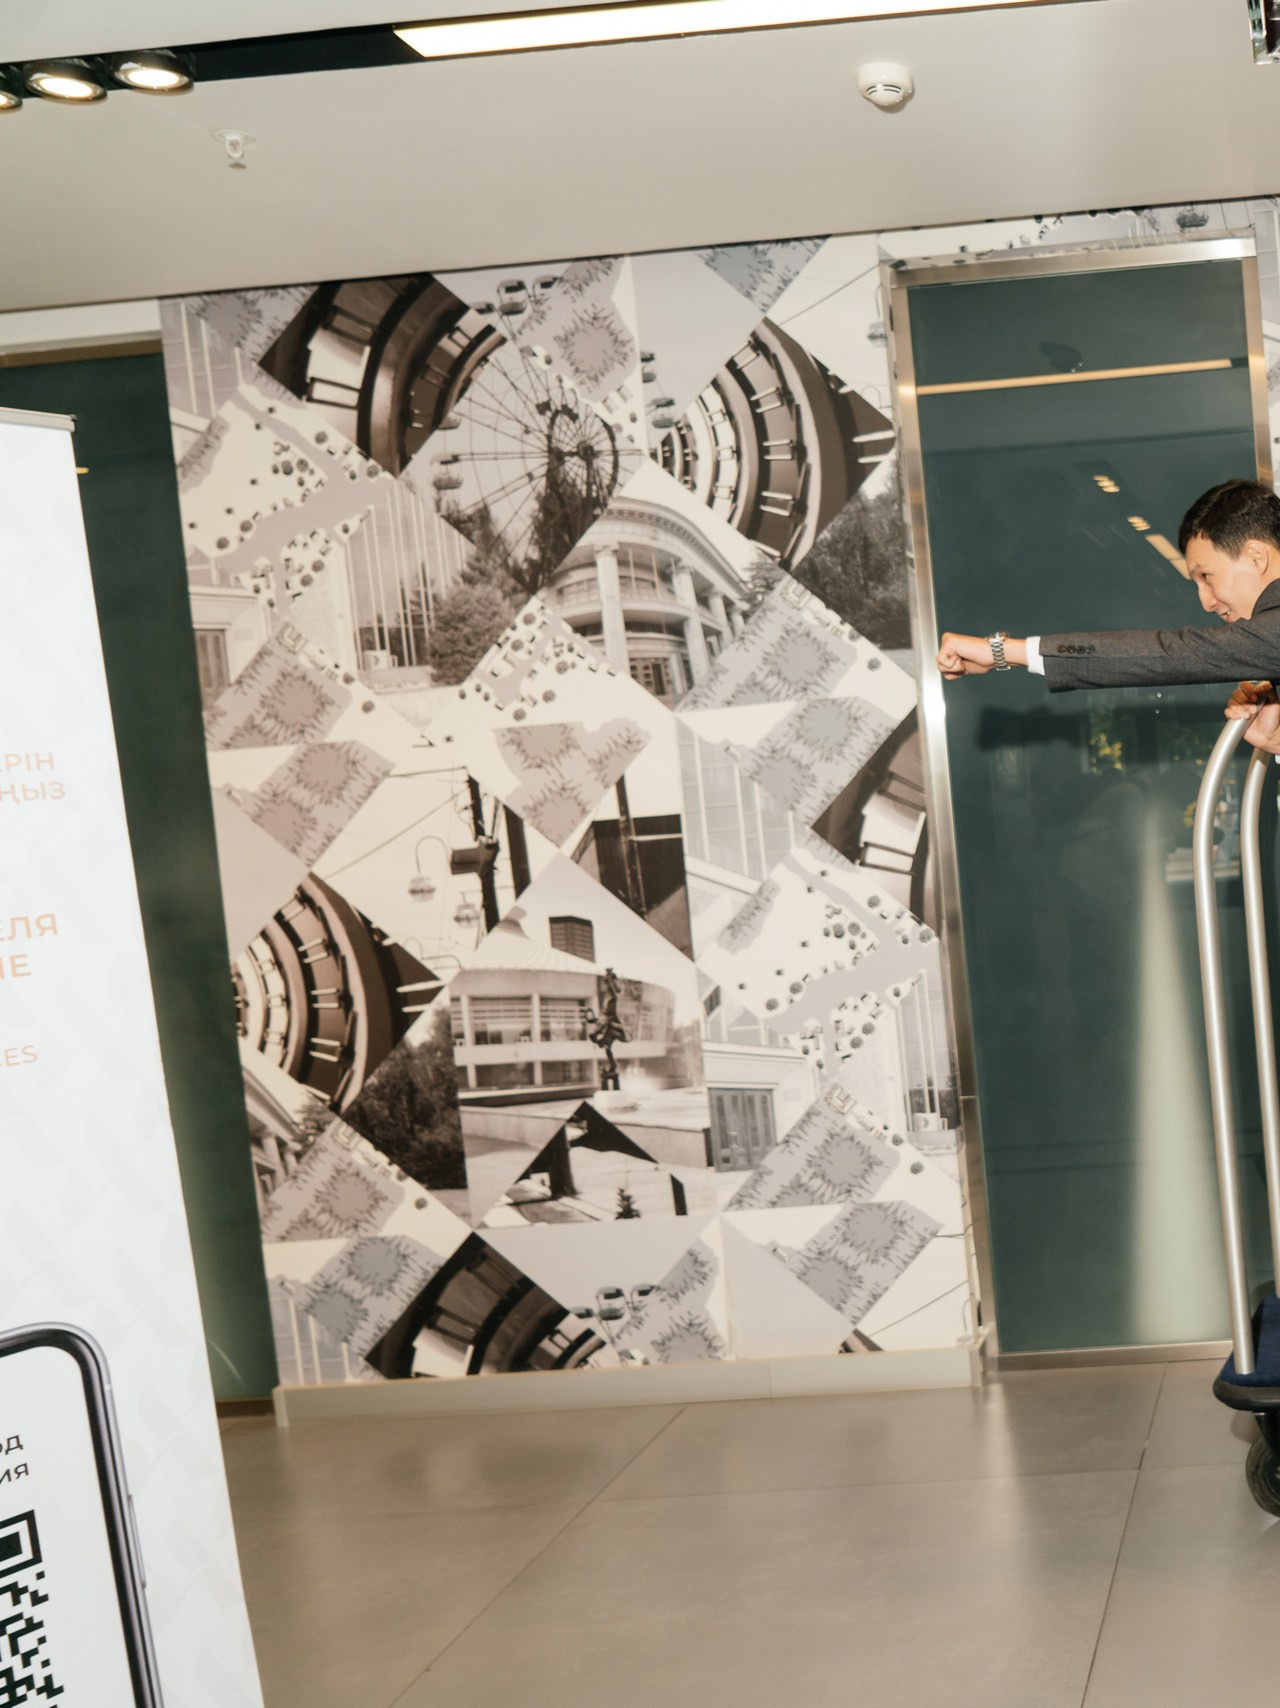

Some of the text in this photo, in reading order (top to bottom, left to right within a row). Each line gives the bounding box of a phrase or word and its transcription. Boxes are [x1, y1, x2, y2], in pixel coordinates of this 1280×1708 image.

[0, 752, 54, 772] РІН
[0, 913, 58, 941] ЛЯ
[0, 954, 32, 979] Е
[0, 1044, 38, 1067] ES
